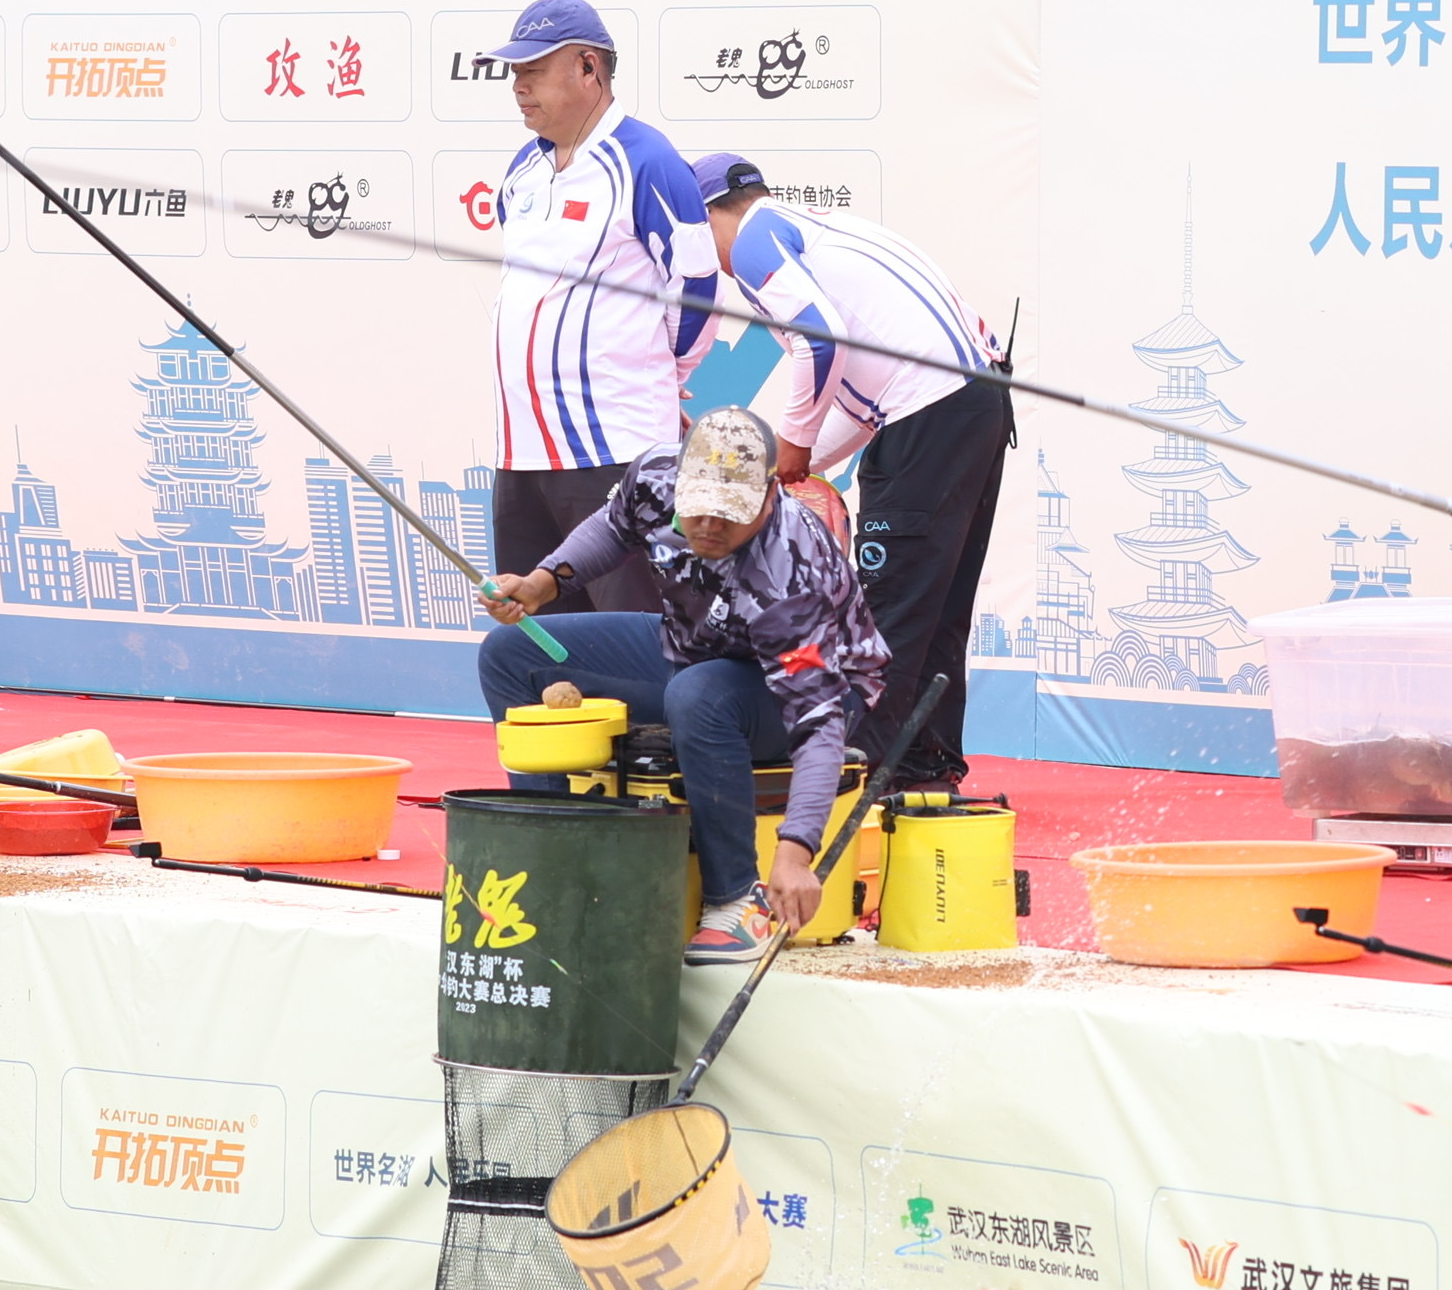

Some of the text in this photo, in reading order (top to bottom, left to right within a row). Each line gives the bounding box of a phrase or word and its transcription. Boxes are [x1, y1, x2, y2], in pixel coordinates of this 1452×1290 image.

[515, 17, 556, 37] CAA
[46, 58, 166, 97] 开拓顶点
[865, 521, 891, 531] CAA
[100, 1108, 244, 1133] KAITUO DINGDIAN
[92, 1126, 245, 1194] 开拓顶点
[947, 1207, 1095, 1260] 武汉东湖风景区
[990, 1251, 1010, 1267] East
[1013, 1255, 1036, 1272] Lake
[1075, 1264, 1098, 1281] Area
